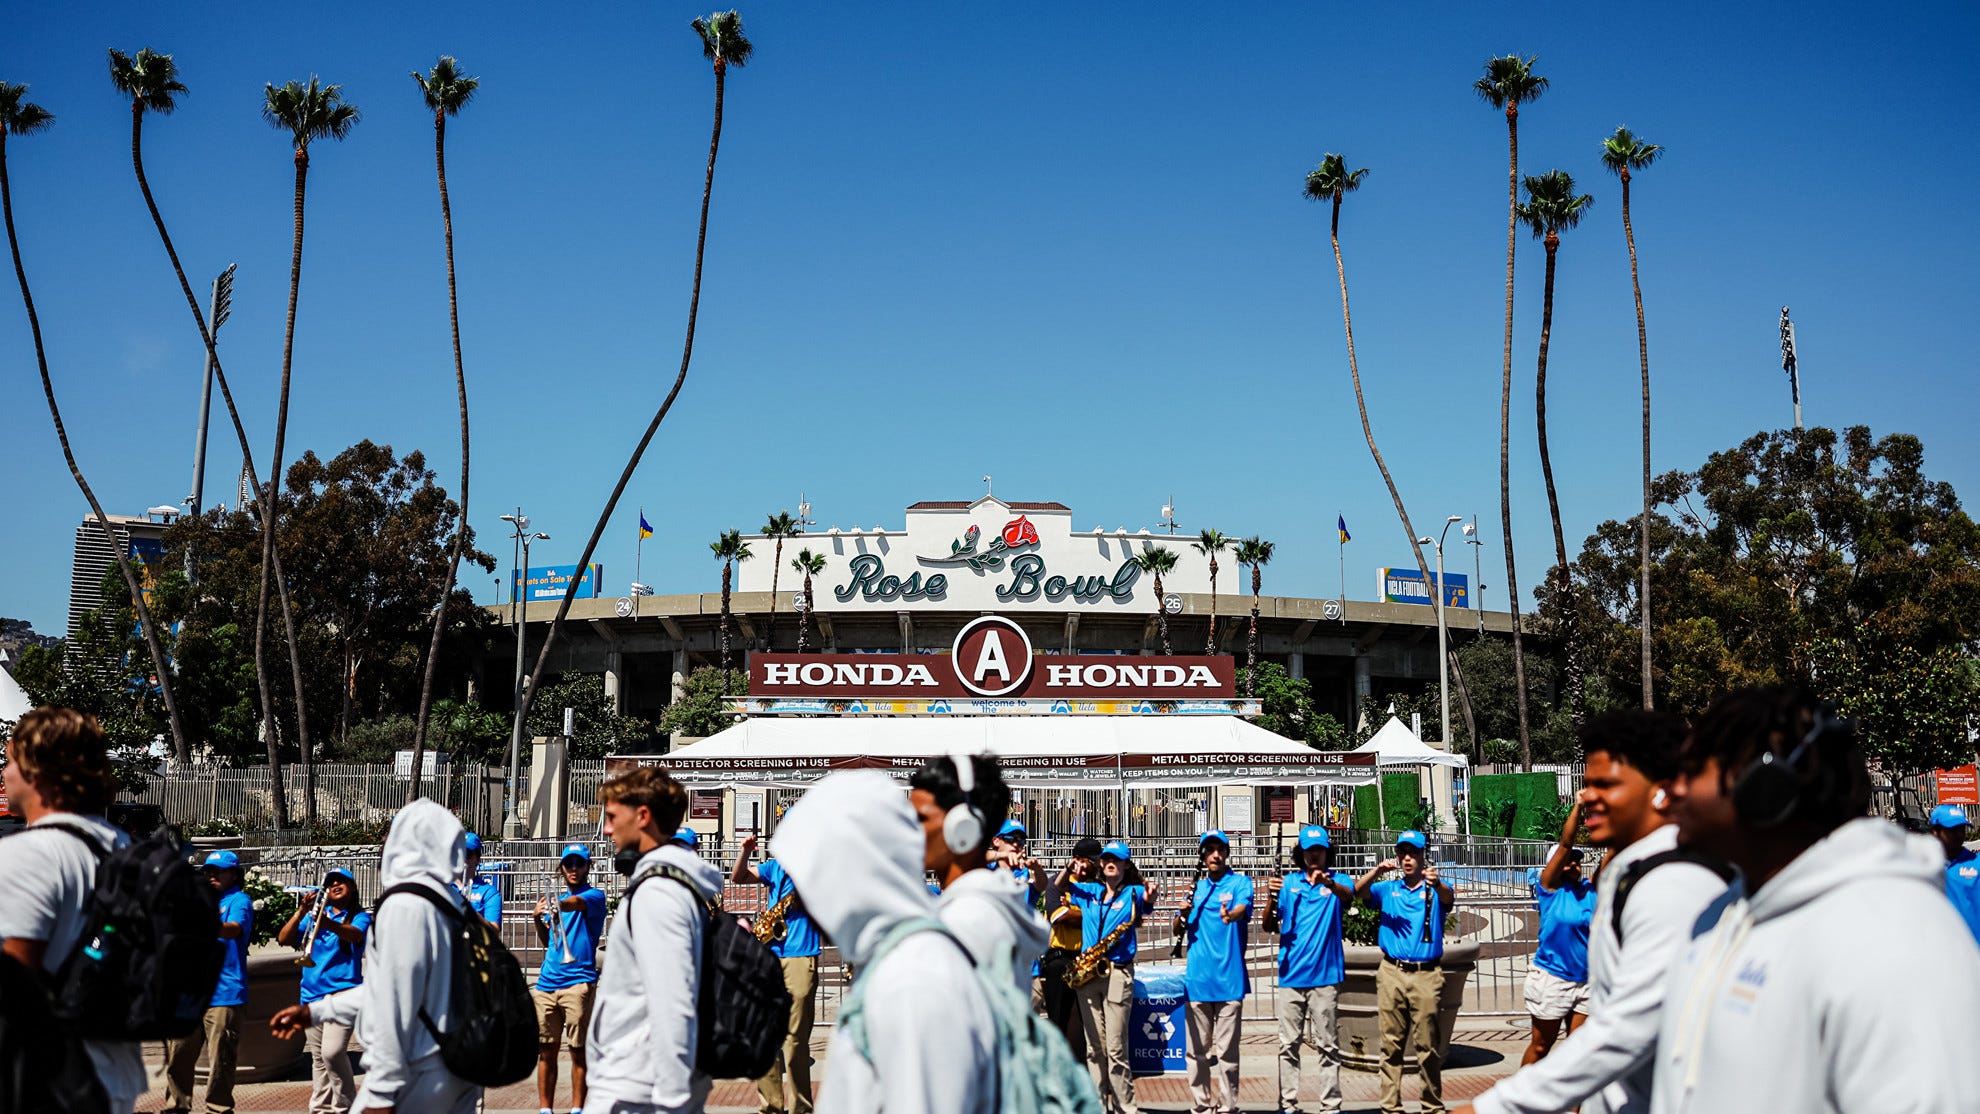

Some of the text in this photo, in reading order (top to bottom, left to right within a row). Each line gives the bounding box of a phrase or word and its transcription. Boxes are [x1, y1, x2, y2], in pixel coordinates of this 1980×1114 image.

[834, 553, 1142, 600] Rose Bowl
[1388, 580, 1402, 596] UCLA
[617, 601, 630, 612] 24
[1166, 597, 1181, 609] 26
[1325, 605, 1338, 615] 27
[973, 630, 1010, 681] A
[763, 663, 939, 686] HONDA
[1046, 664, 1221, 687] HONDA
[971, 699, 1027, 707] welcome to
[638, 759, 830, 769] METAL DETECTOR SCREENING IN USE
[892, 758, 926, 766] METAL
[997, 757, 1087, 766] CREENING IN USE
[1151, 755, 1344, 764] METAL DETECTOR SCREENING IN USE
[1170, 768, 1182, 776] ON
[1148, 997, 1177, 1006] CANS
[1134, 1048, 1183, 1059] RECYCLE
